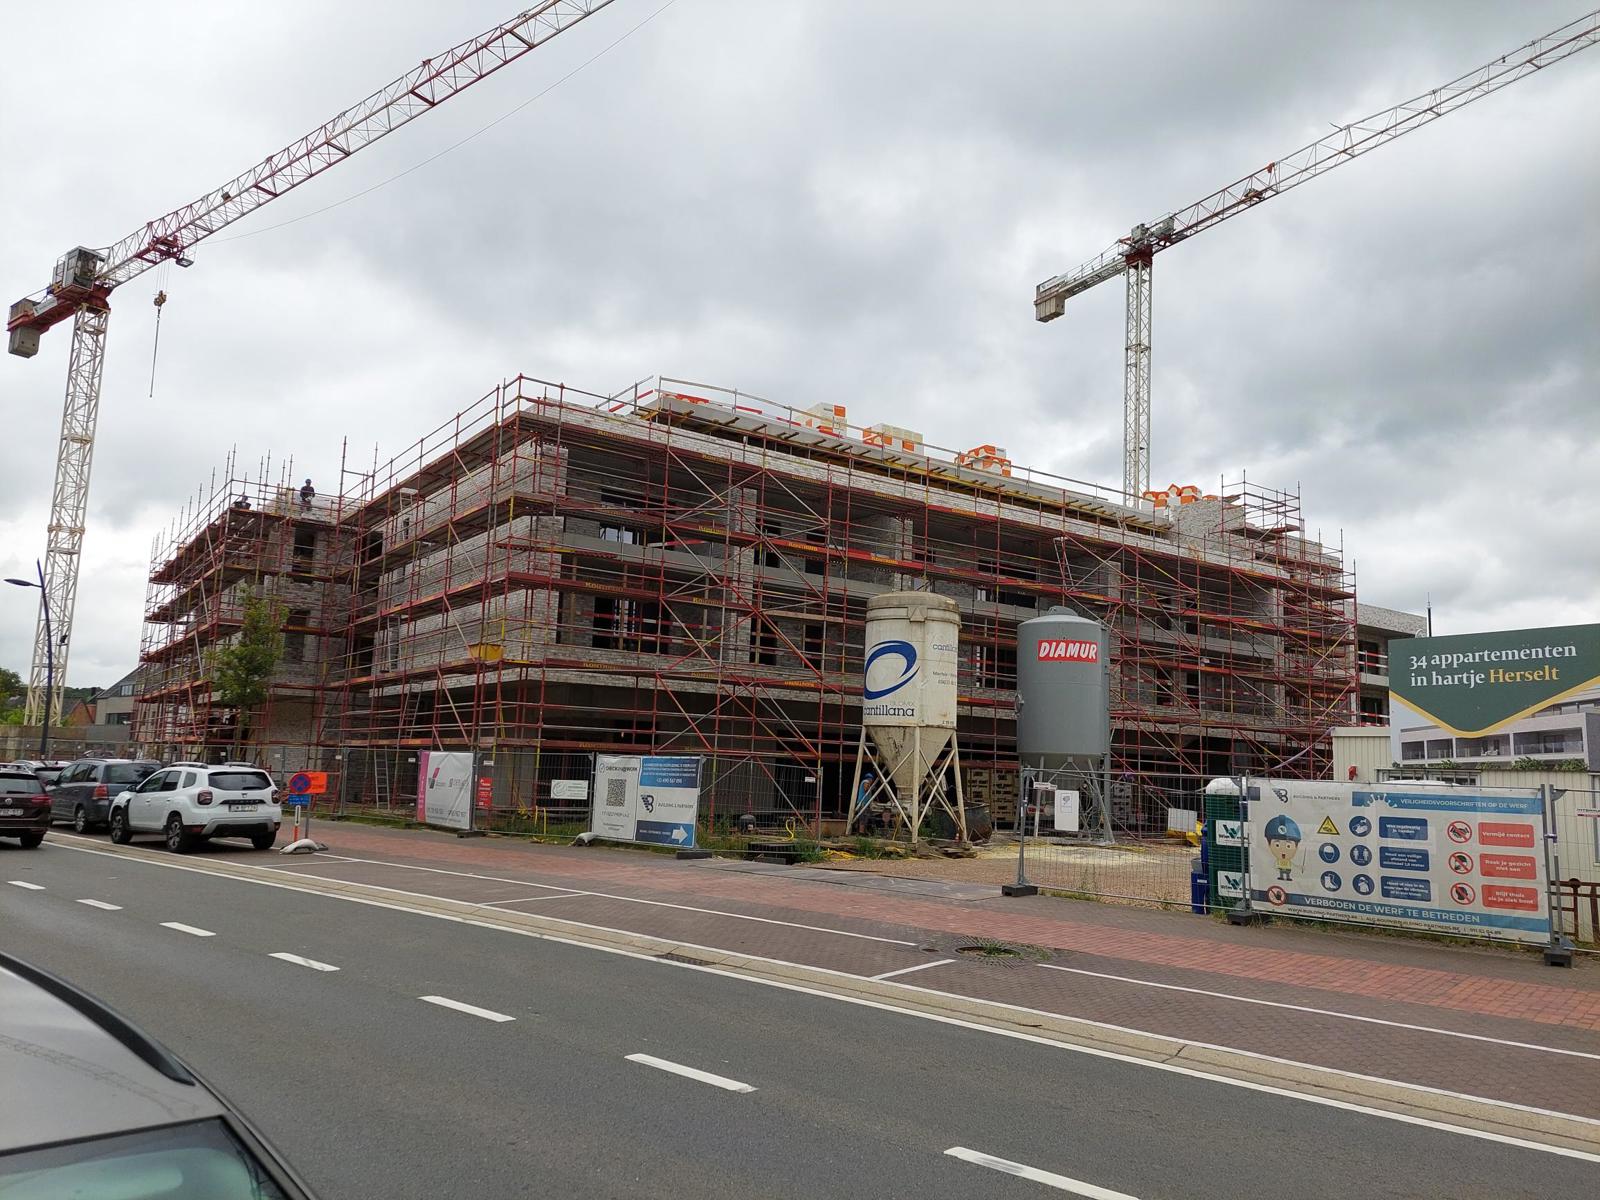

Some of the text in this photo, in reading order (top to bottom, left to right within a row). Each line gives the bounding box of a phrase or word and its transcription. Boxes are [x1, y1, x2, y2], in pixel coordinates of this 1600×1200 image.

[1039, 641, 1097, 660] DIAMUR
[1409, 644, 1578, 670] 34 appartementen
[1410, 665, 1560, 689] in hartje Herselt
[1400, 799, 1487, 808] VEILIGHEIDSVOORSCHRIFTEN
[1304, 896, 1356, 910] VERBODEN
[1373, 906, 1404, 915] WERF
[1407, 909, 1420, 917] TE
[1422, 910, 1480, 923] BETREDEN
